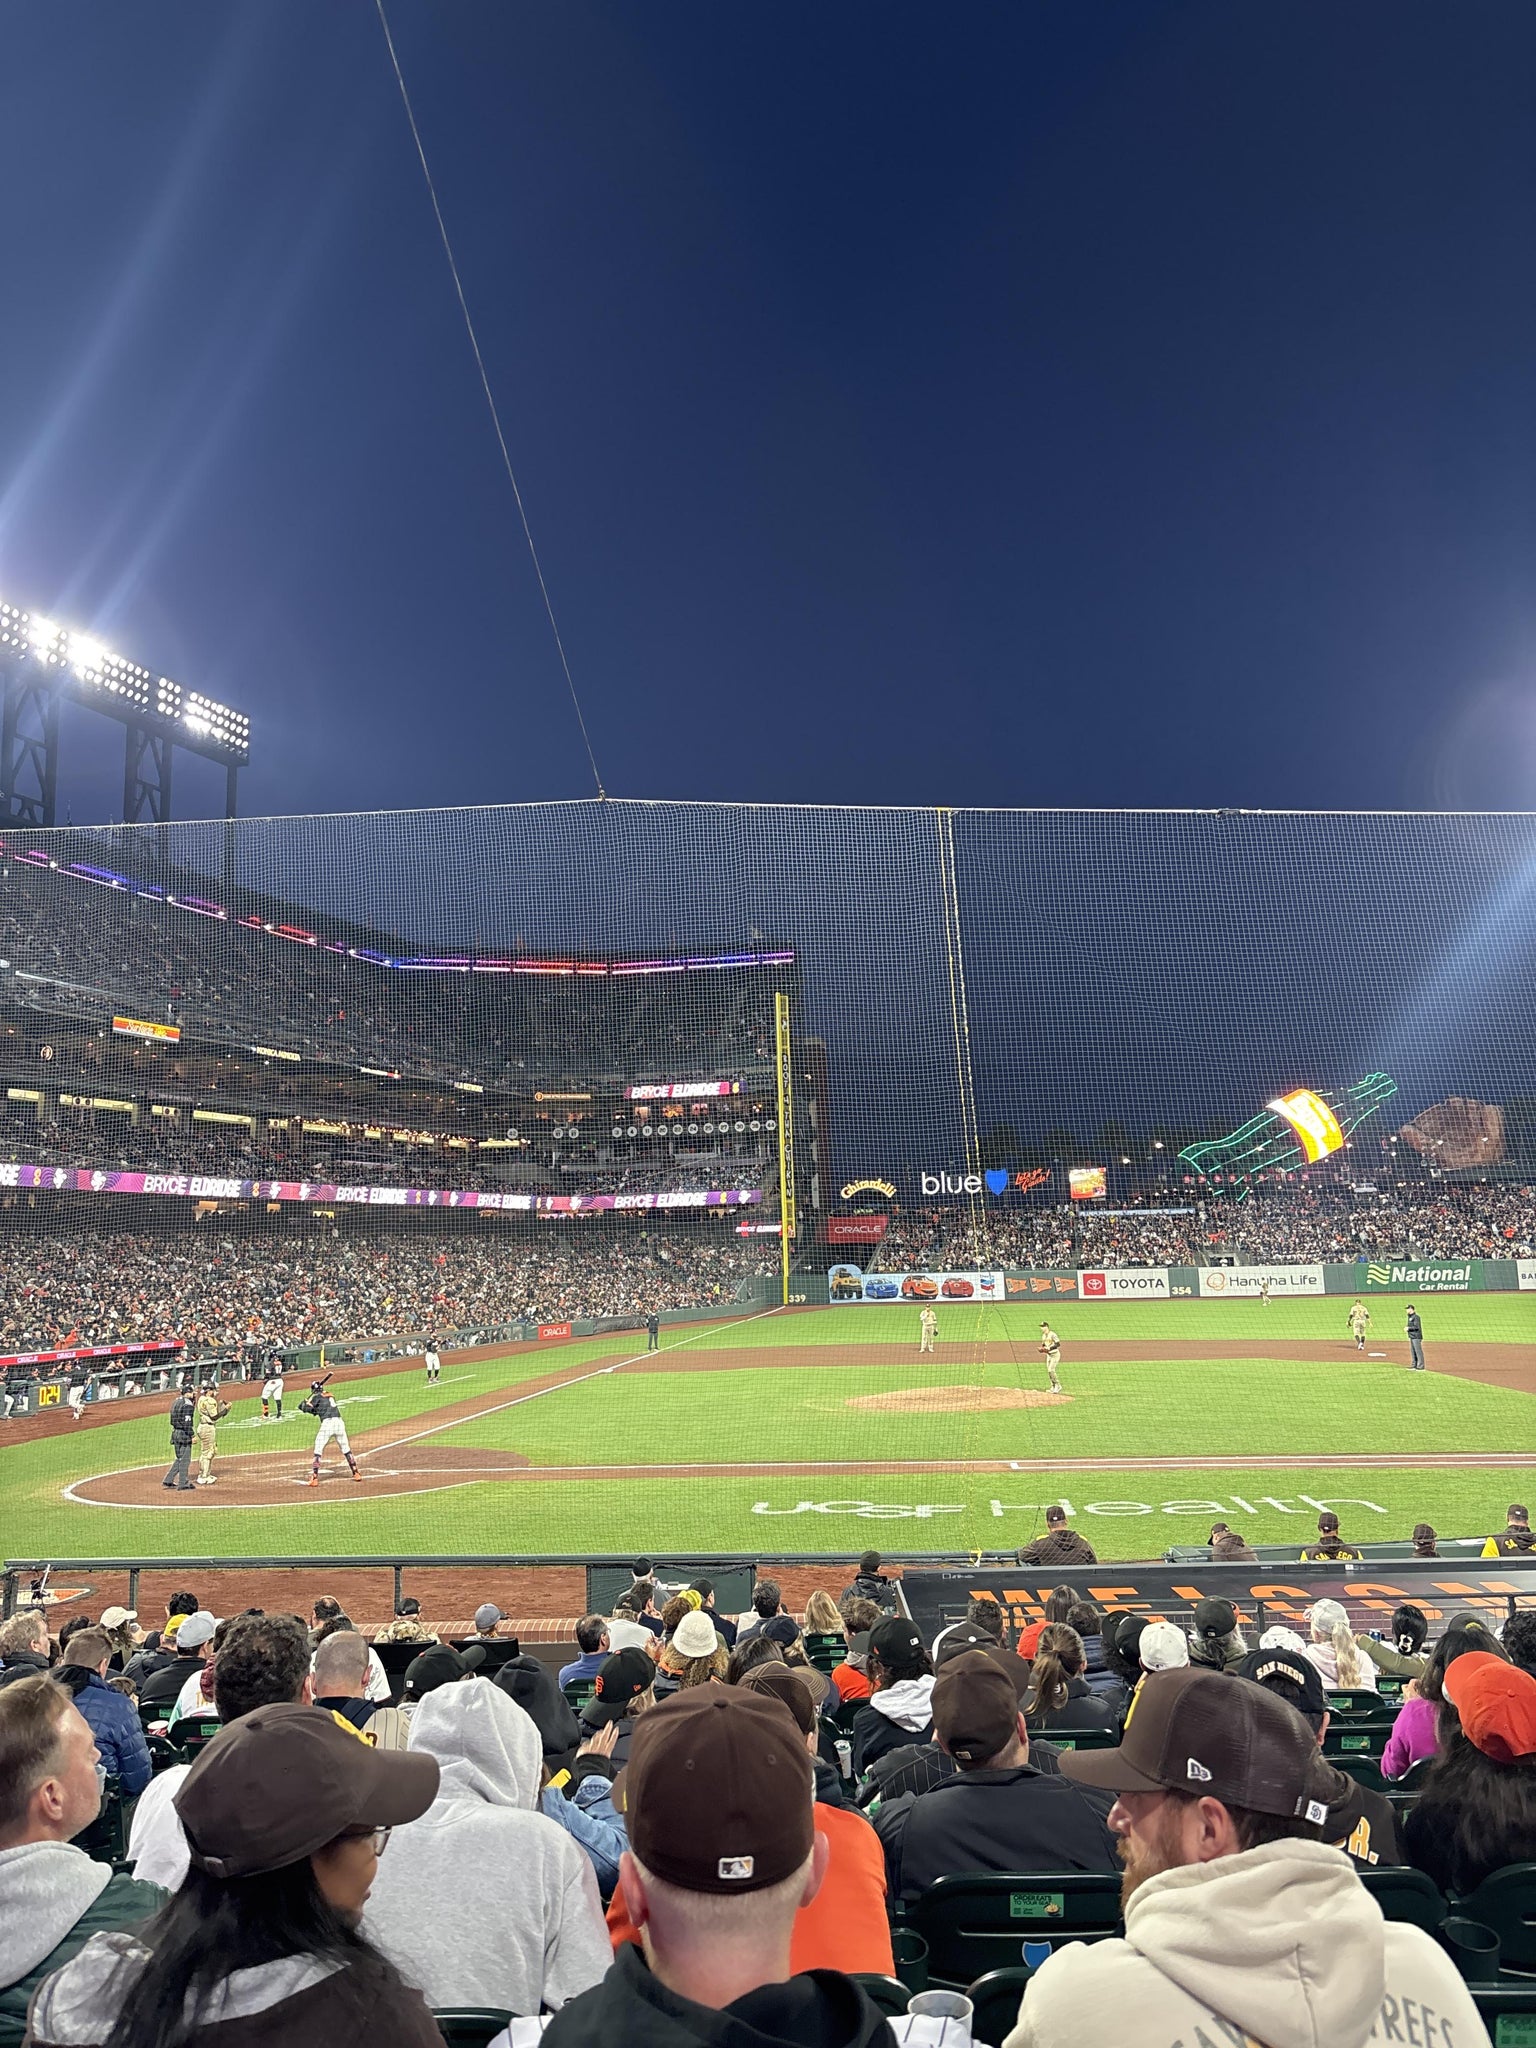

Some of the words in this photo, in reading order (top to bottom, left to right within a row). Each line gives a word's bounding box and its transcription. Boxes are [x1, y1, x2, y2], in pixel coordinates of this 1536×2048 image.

[631, 1085, 670, 1099] BRYCE
[671, 1082, 721, 1098] ELDRIDGE
[143, 1176, 188, 1194] BRYCE
[189, 1178, 242, 1197] ELDRIDGE
[840, 1178, 897, 1199] Ghirardelli
[921, 1170, 982, 1195] blue
[335, 1187, 368, 1202] BRYCE
[369, 1188, 408, 1204] ELDRIDGE
[477, 1194, 502, 1208] BRYCE
[614, 1195, 654, 1209] BRYCE
[655, 1192, 708, 1208] ELDRIDGE
[834, 1225, 882, 1234] ORACLE
[1290, 1275, 1318, 1286] Life
[1391, 1264, 1471, 1282] National
[1111, 1278, 1165, 1289] TOYOTA
[1171, 1286, 1192, 1295] 354
[1419, 1283, 1436, 1291] Car
[1437, 1282, 1468, 1291] Rental
[788, 1294, 806, 1303] 339
[543, 1326, 568, 1337] ORACLE
[38, 1385, 61, 1406] 024
[750, 1501, 967, 1519] UCSF
[989, 1494, 1391, 1517] Health
[1256, 1660, 1276, 1681] SAN
[1276, 1661, 1305, 1685] DIEGO
